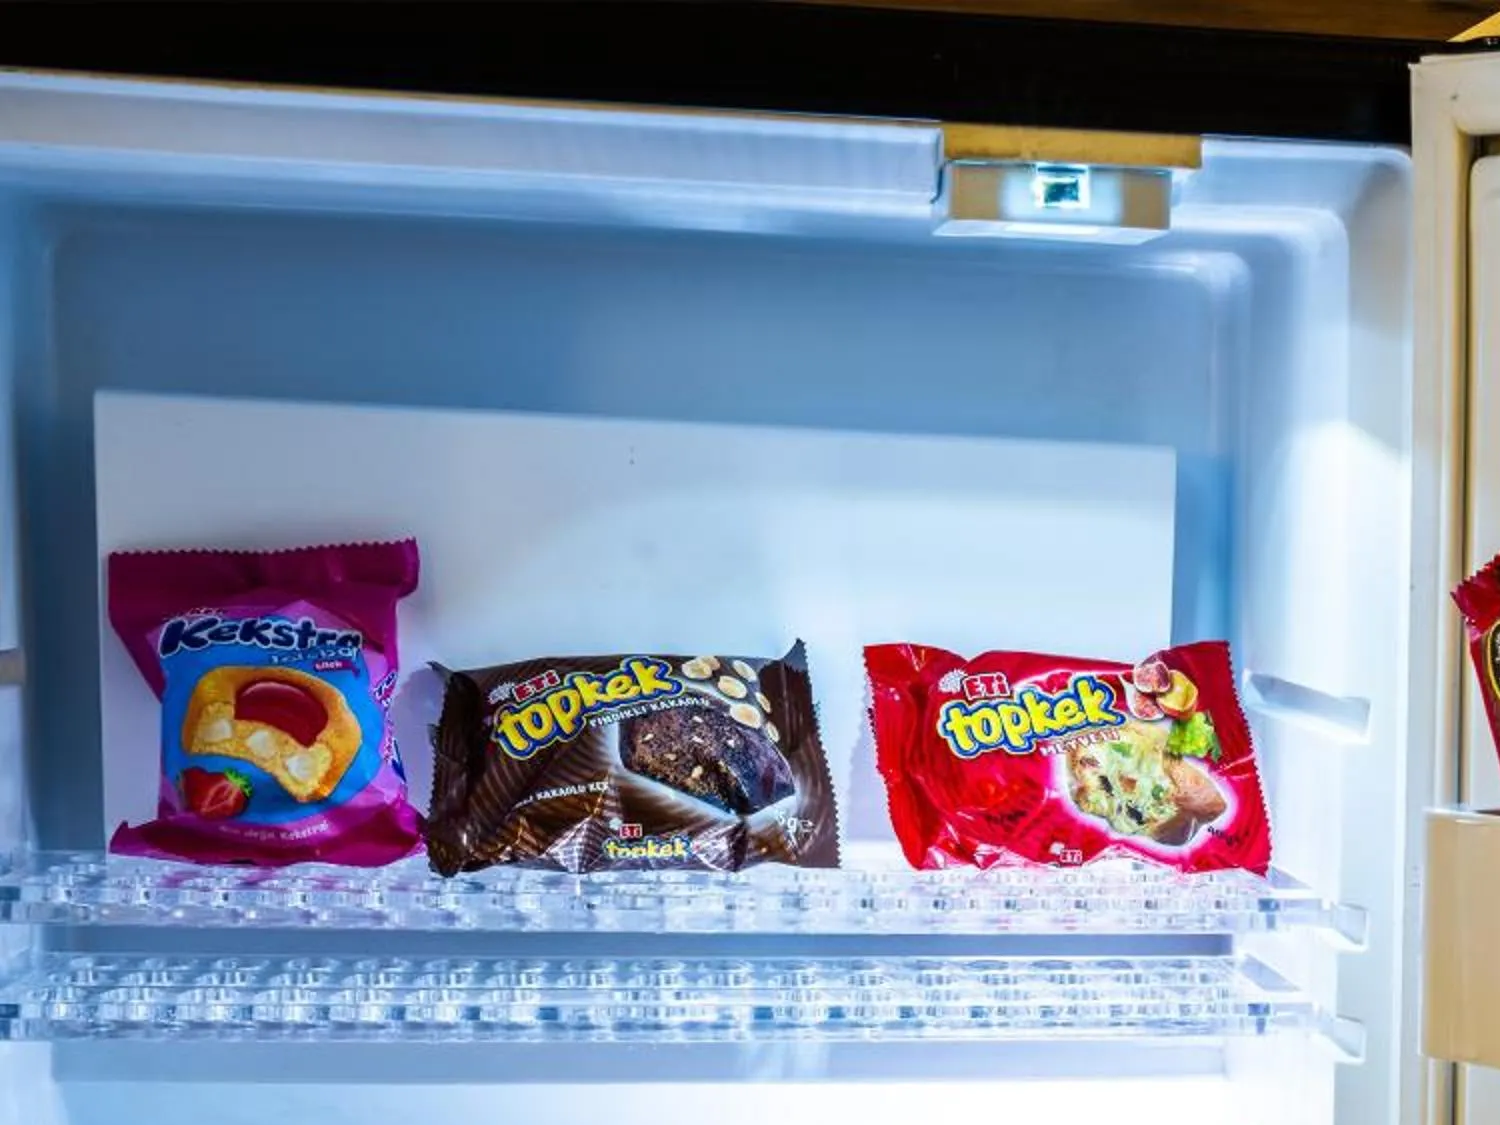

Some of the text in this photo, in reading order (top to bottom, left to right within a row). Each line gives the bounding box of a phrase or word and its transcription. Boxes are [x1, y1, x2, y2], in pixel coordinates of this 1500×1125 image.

[158, 615, 363, 659] Kekstra
[496, 657, 680, 755] topkek
[944, 677, 1119, 753] topkek
